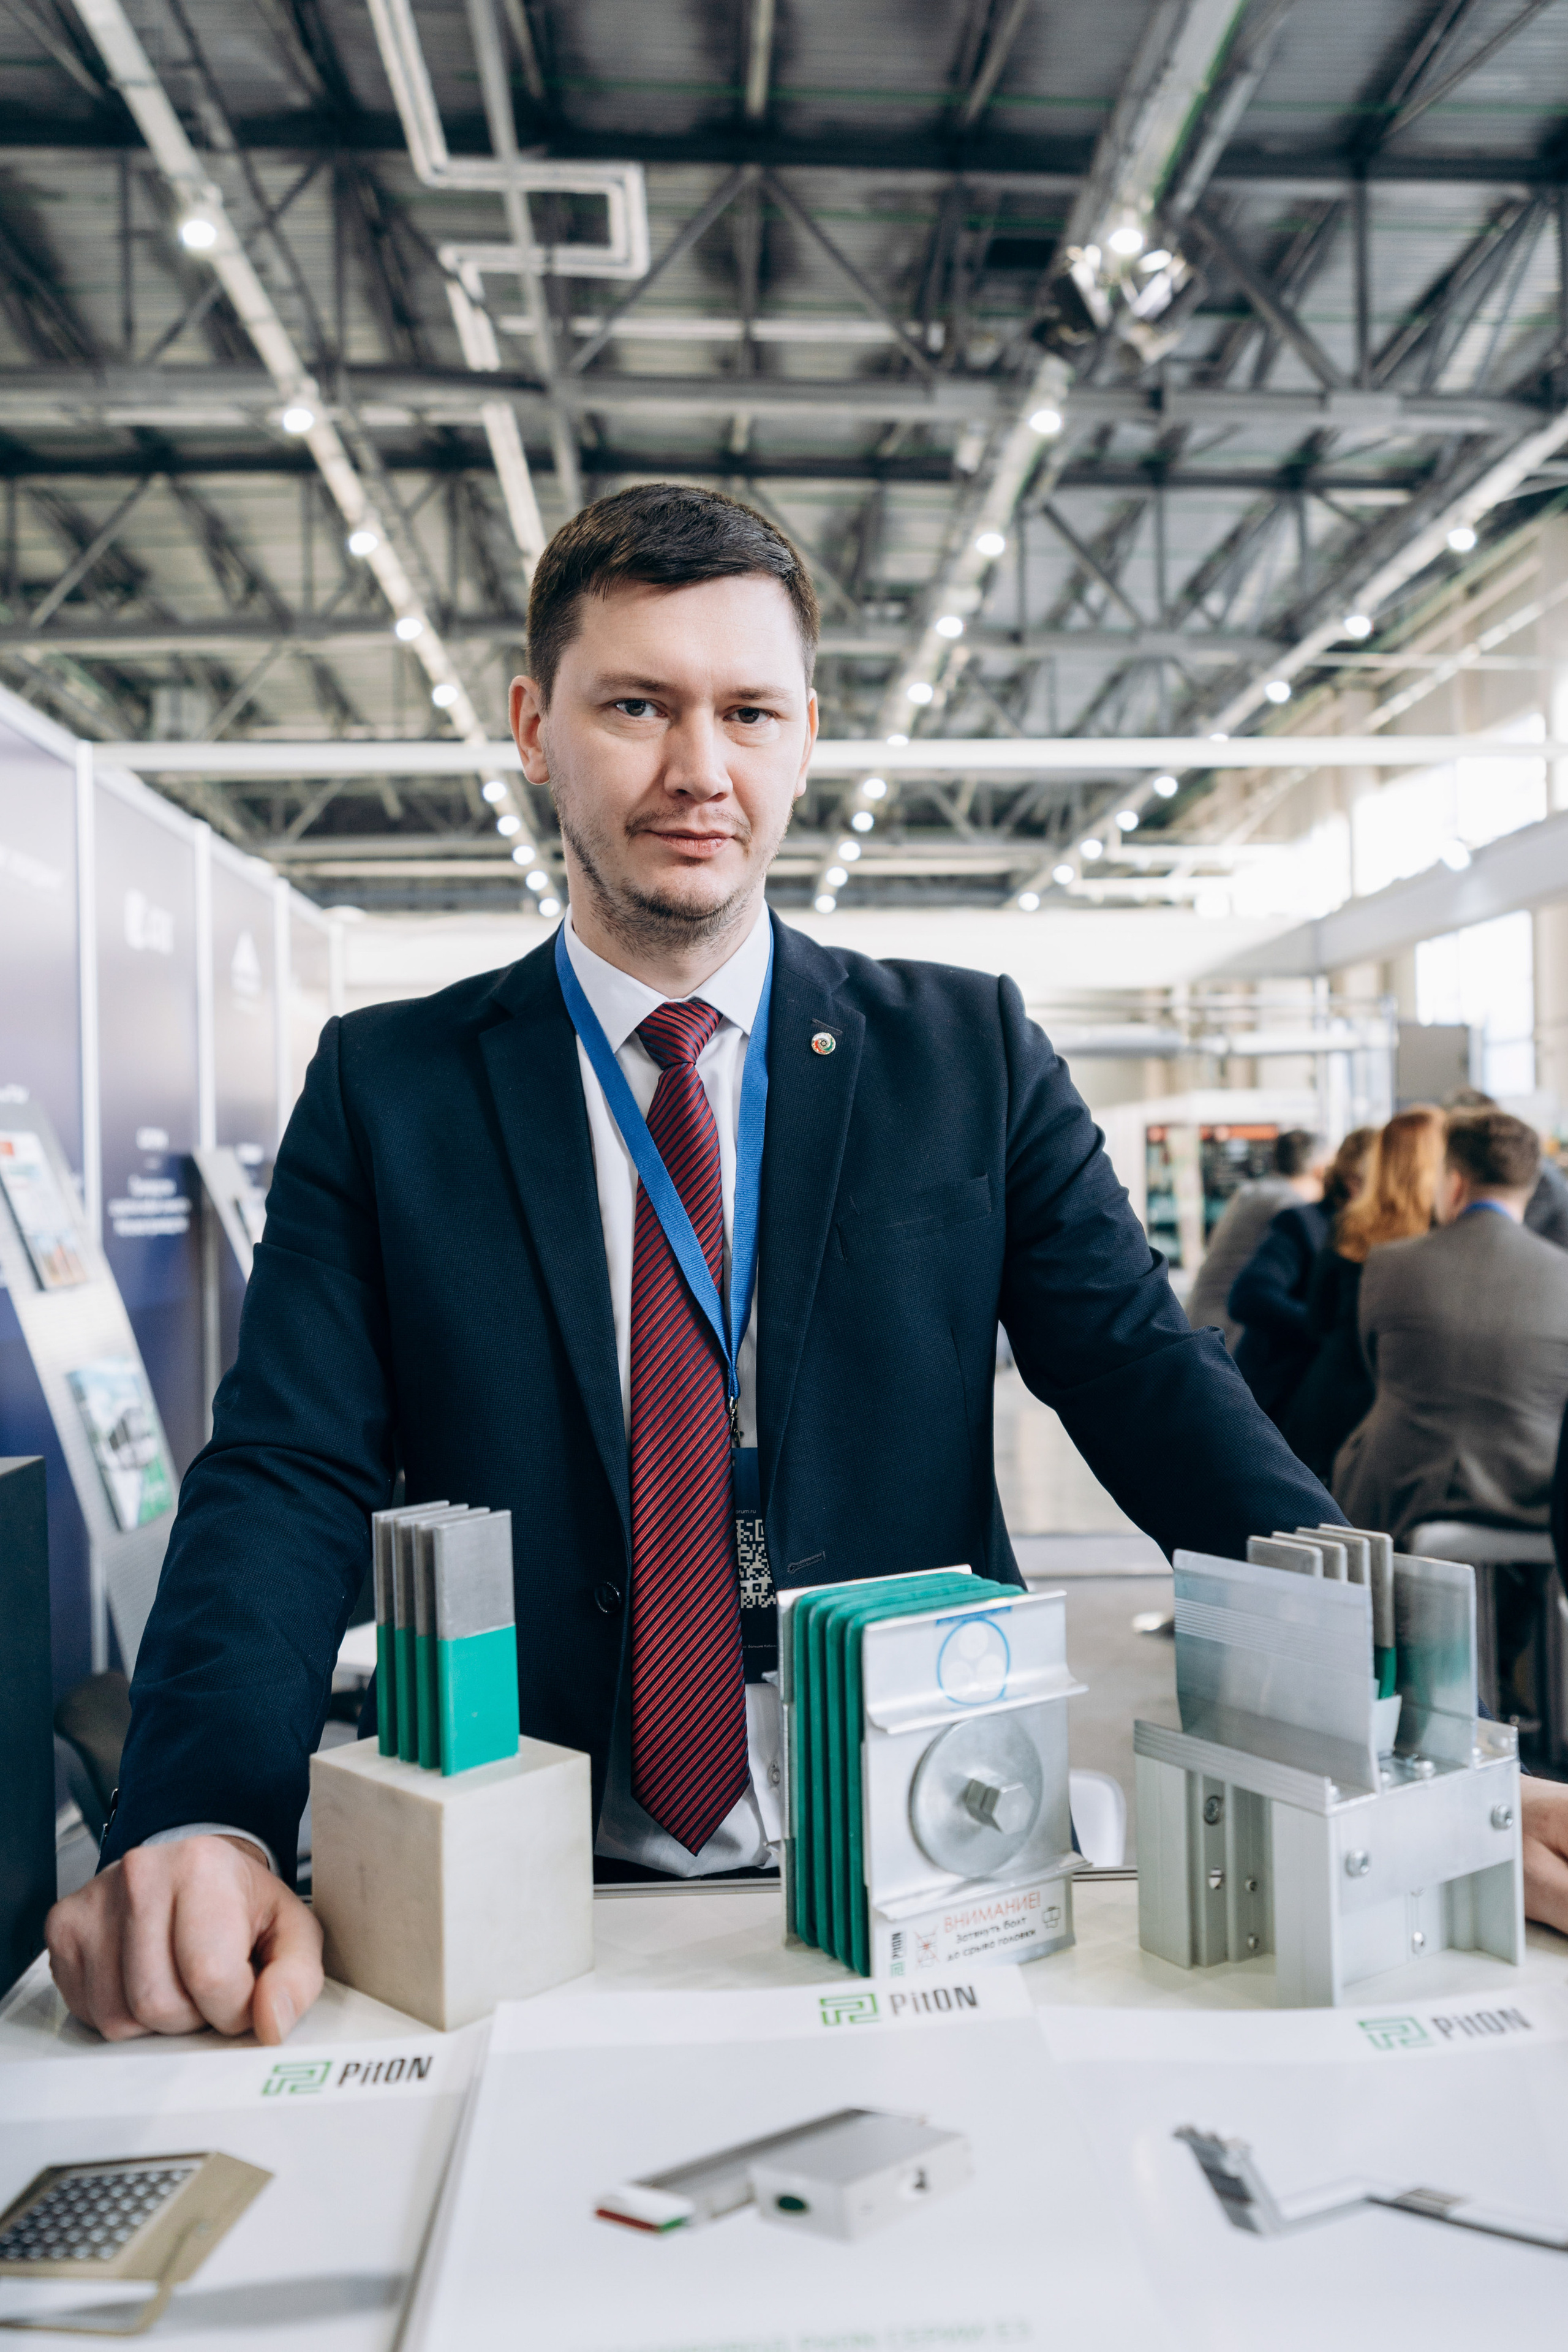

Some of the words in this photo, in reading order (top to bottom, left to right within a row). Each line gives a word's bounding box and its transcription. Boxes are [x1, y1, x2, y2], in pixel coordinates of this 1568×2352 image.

[944, 1891, 1041, 1934] ВНИМАНИЕ!
[948, 1951, 960, 1961] до
[963, 1940, 995, 1958] срыва
[998, 1929, 1036, 1947] головки
[956, 1925, 1001, 1943] Затянуть
[1003, 1917, 1027, 1930] болт
[889, 1986, 978, 2016] PitON
[337, 2055, 432, 2086] PitON
